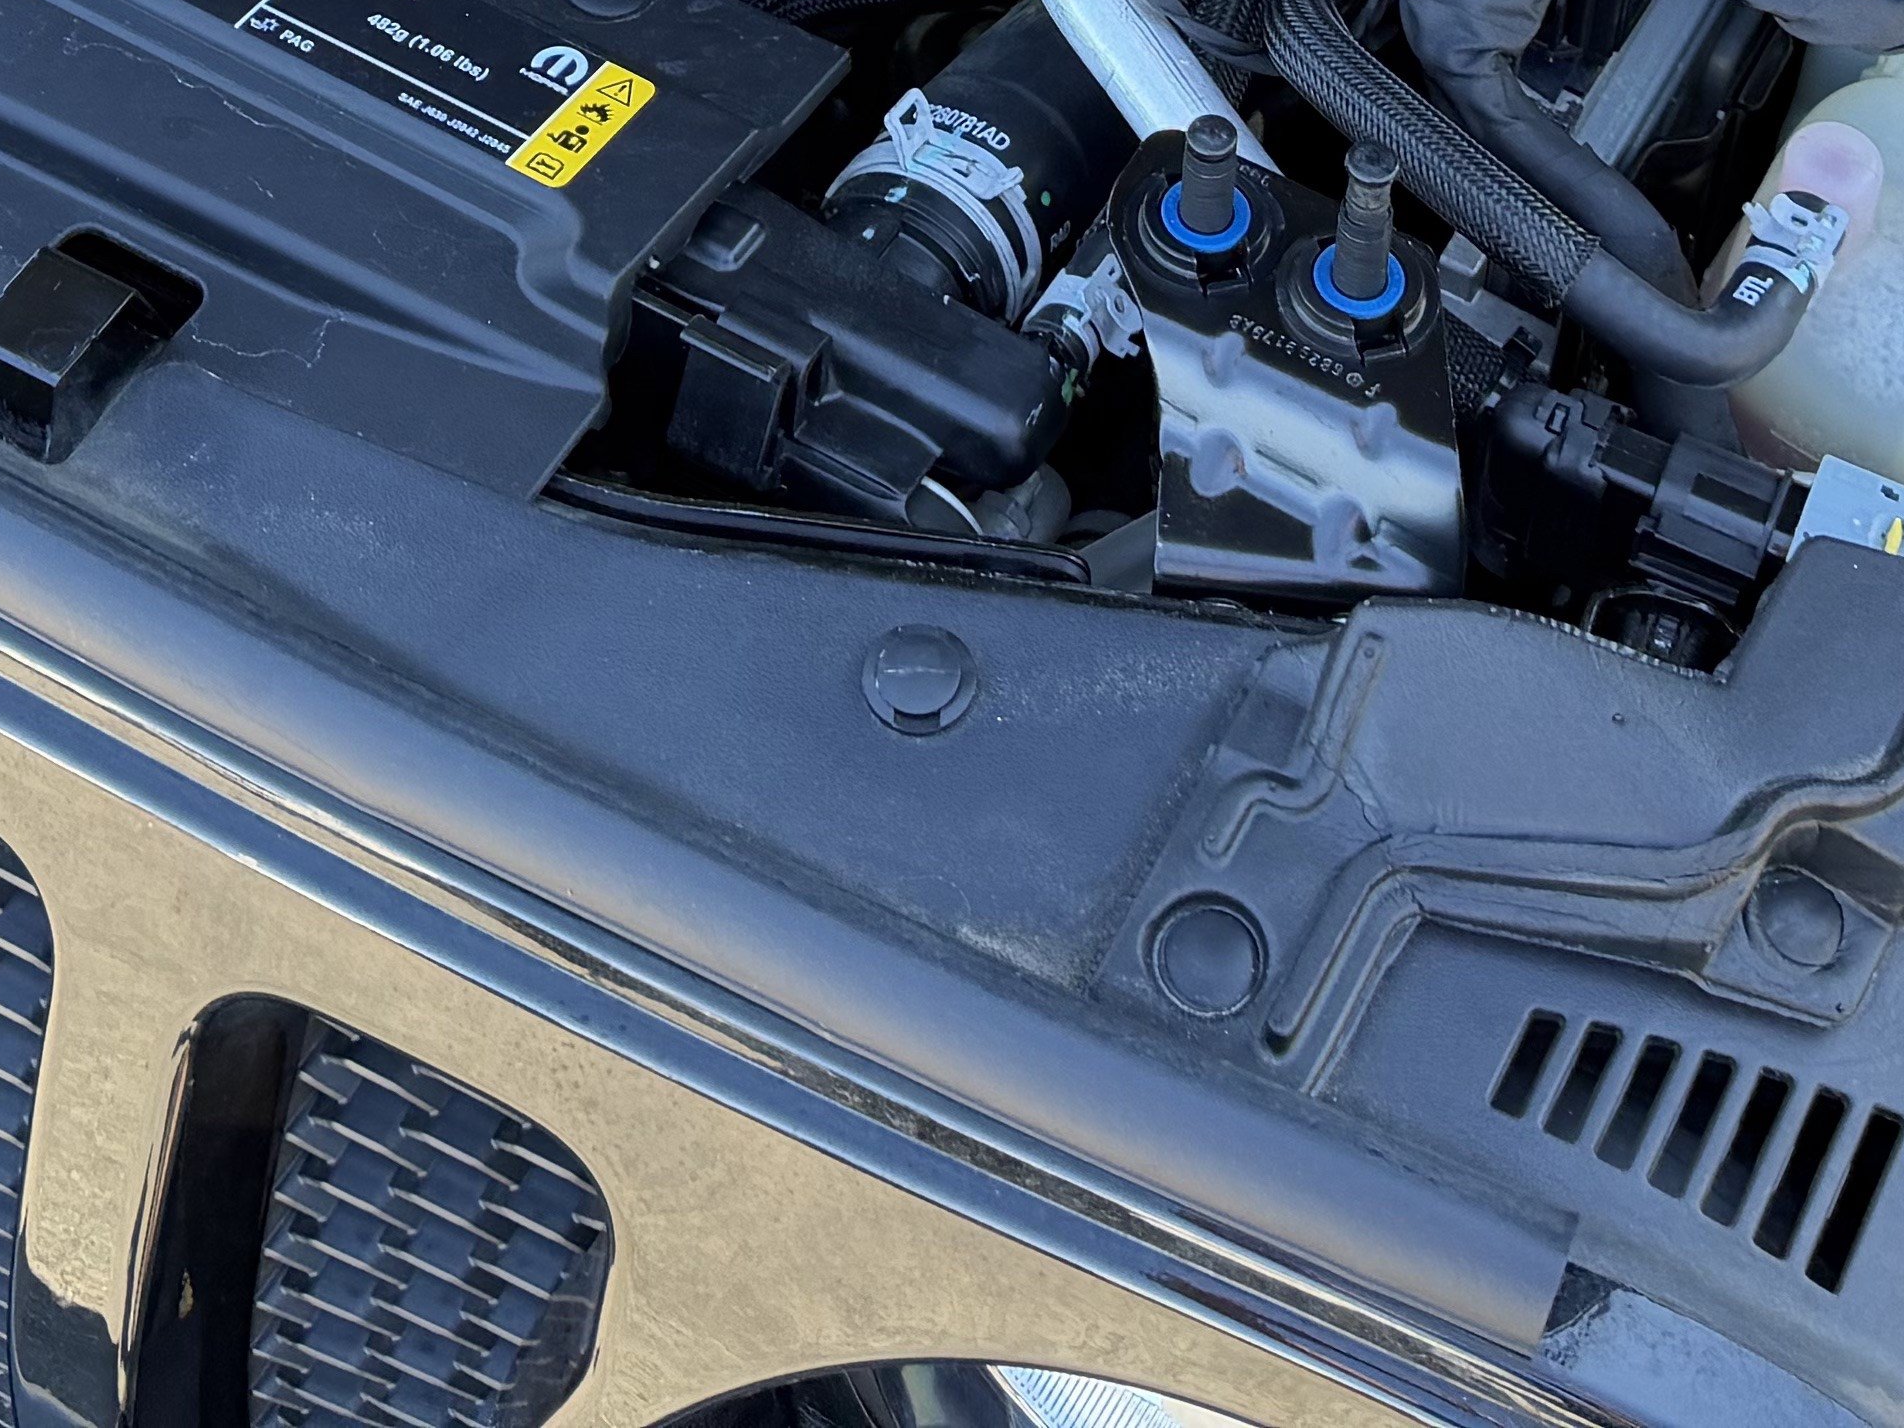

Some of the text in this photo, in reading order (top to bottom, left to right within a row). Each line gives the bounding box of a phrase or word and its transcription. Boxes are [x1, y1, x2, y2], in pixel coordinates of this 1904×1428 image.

[278, 28, 316, 53] PAG
[366, 13, 491, 83] 482g (1.06 lbs)
